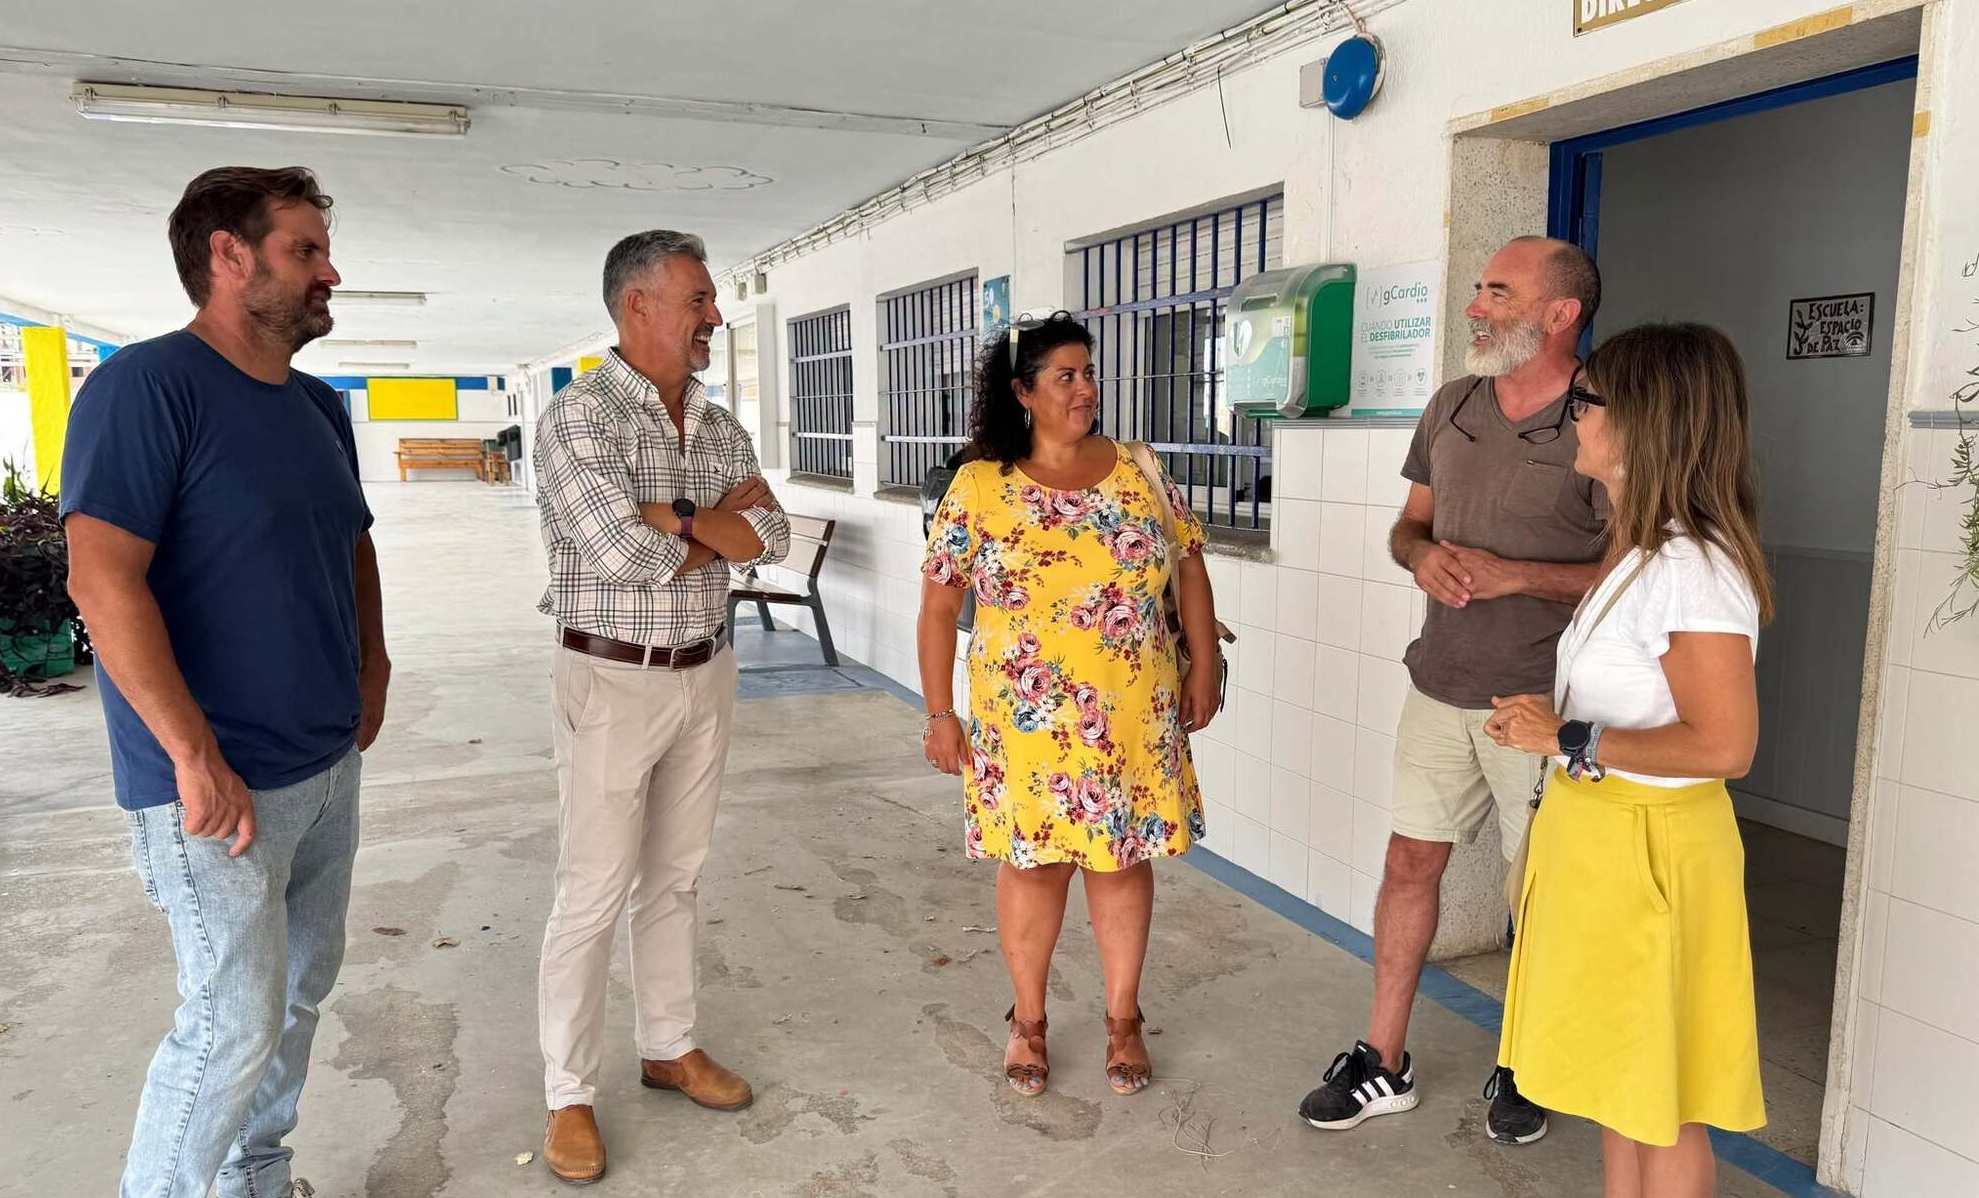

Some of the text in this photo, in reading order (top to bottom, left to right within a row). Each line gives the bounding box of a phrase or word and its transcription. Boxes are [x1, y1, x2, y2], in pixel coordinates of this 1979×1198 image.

[1383, 282, 1427, 305] gCardio
[1808, 300, 1863, 321] ESCUELA:
[1361, 316, 1431, 331] CUANDO UTILIZAR
[1820, 319, 1861, 335] ESPACIO
[1369, 328, 1431, 342] DESFIBRILADOR
[1807, 341, 1820, 354] DE
